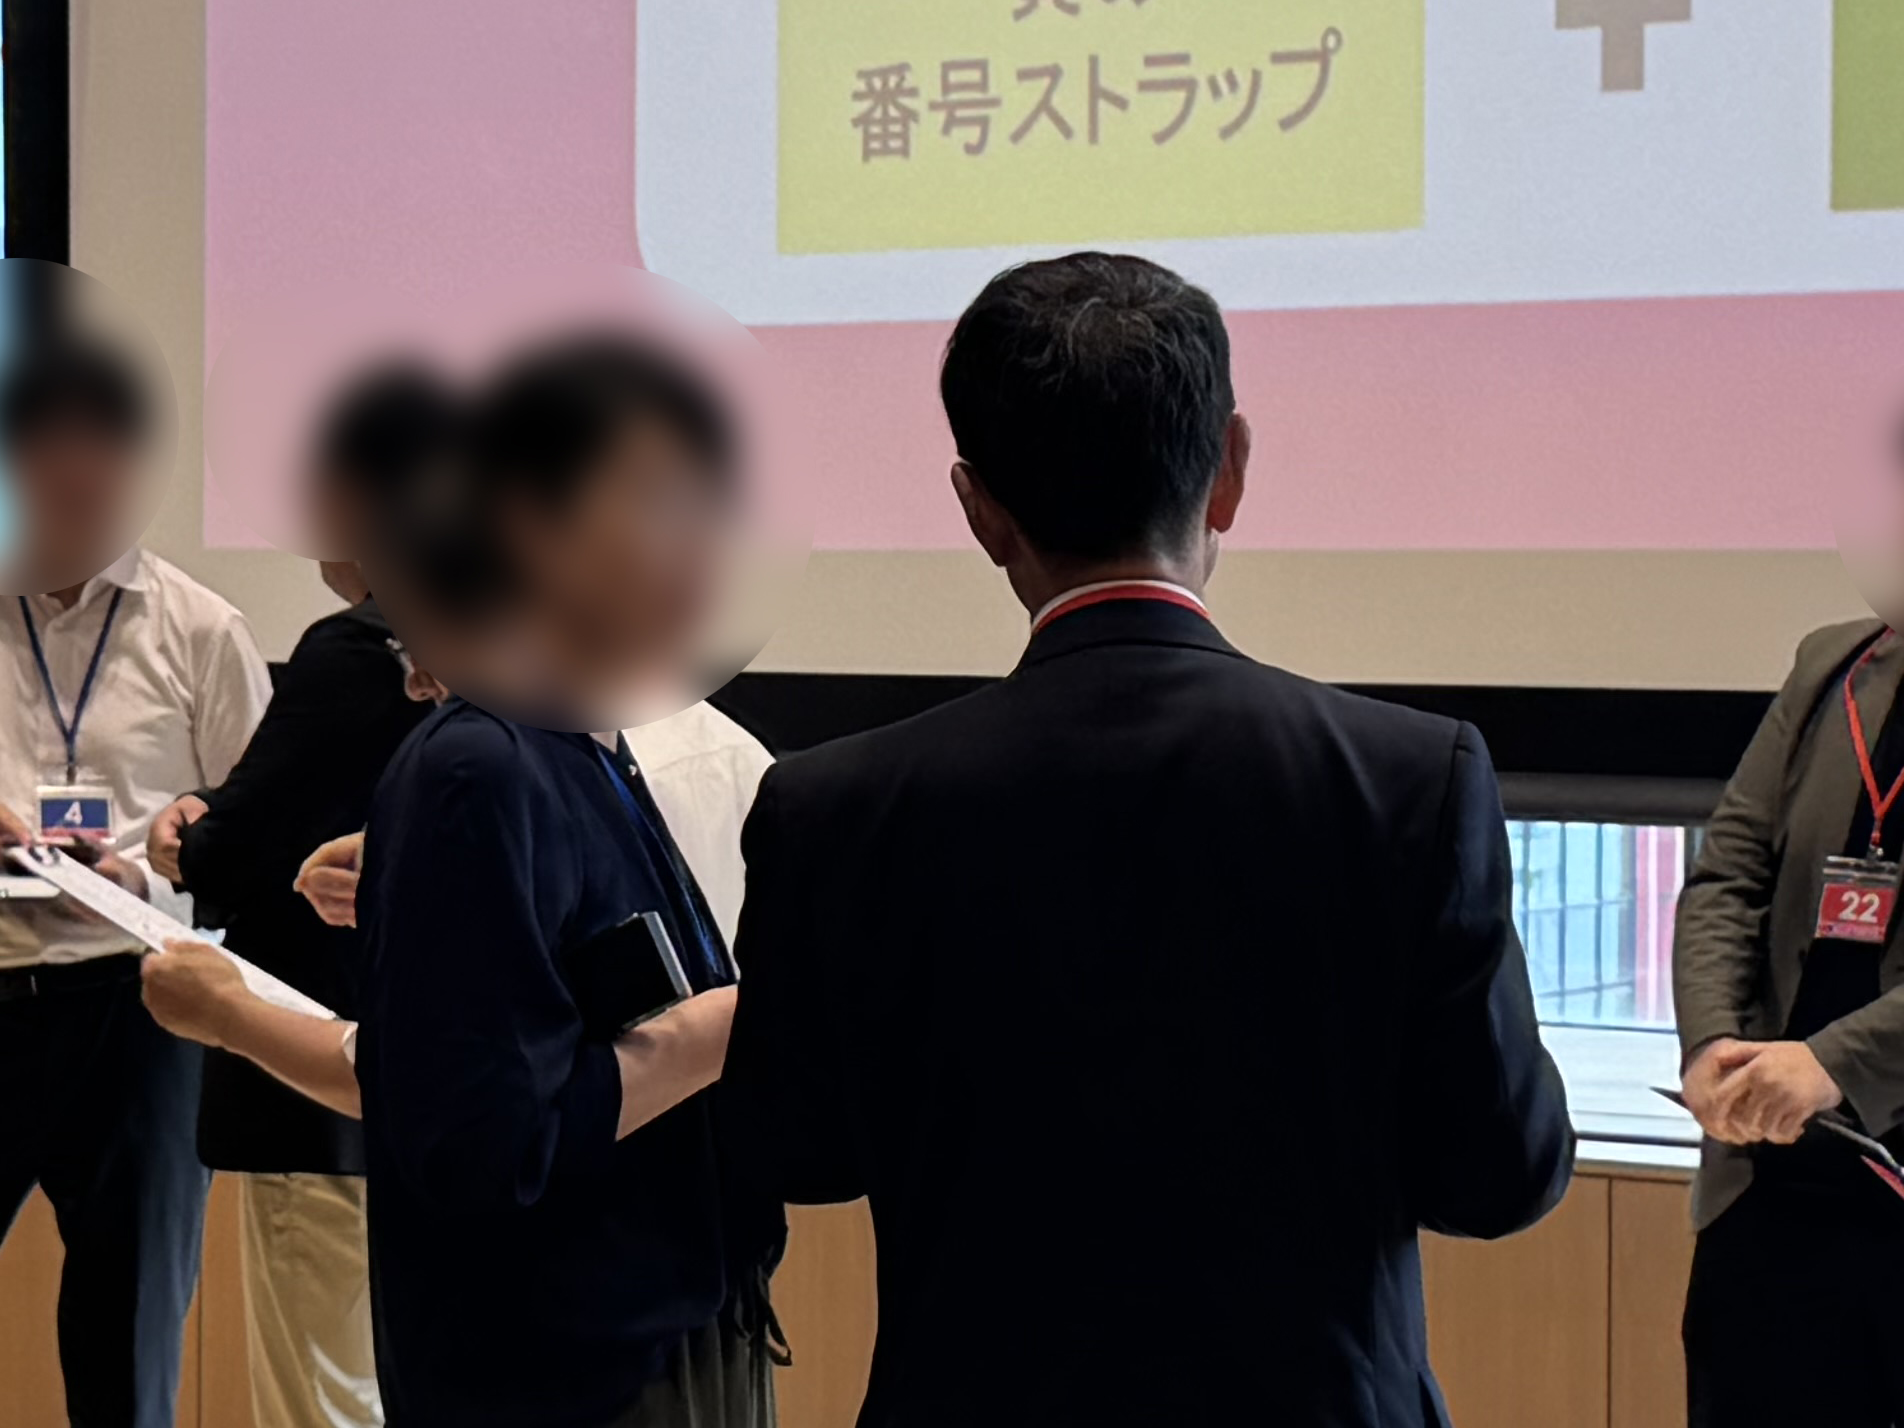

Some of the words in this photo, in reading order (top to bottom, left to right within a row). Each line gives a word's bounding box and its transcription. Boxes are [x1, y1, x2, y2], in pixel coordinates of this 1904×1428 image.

[851, 25, 1344, 166] 番号ストラップ
[1838, 890, 1880, 923] 22
